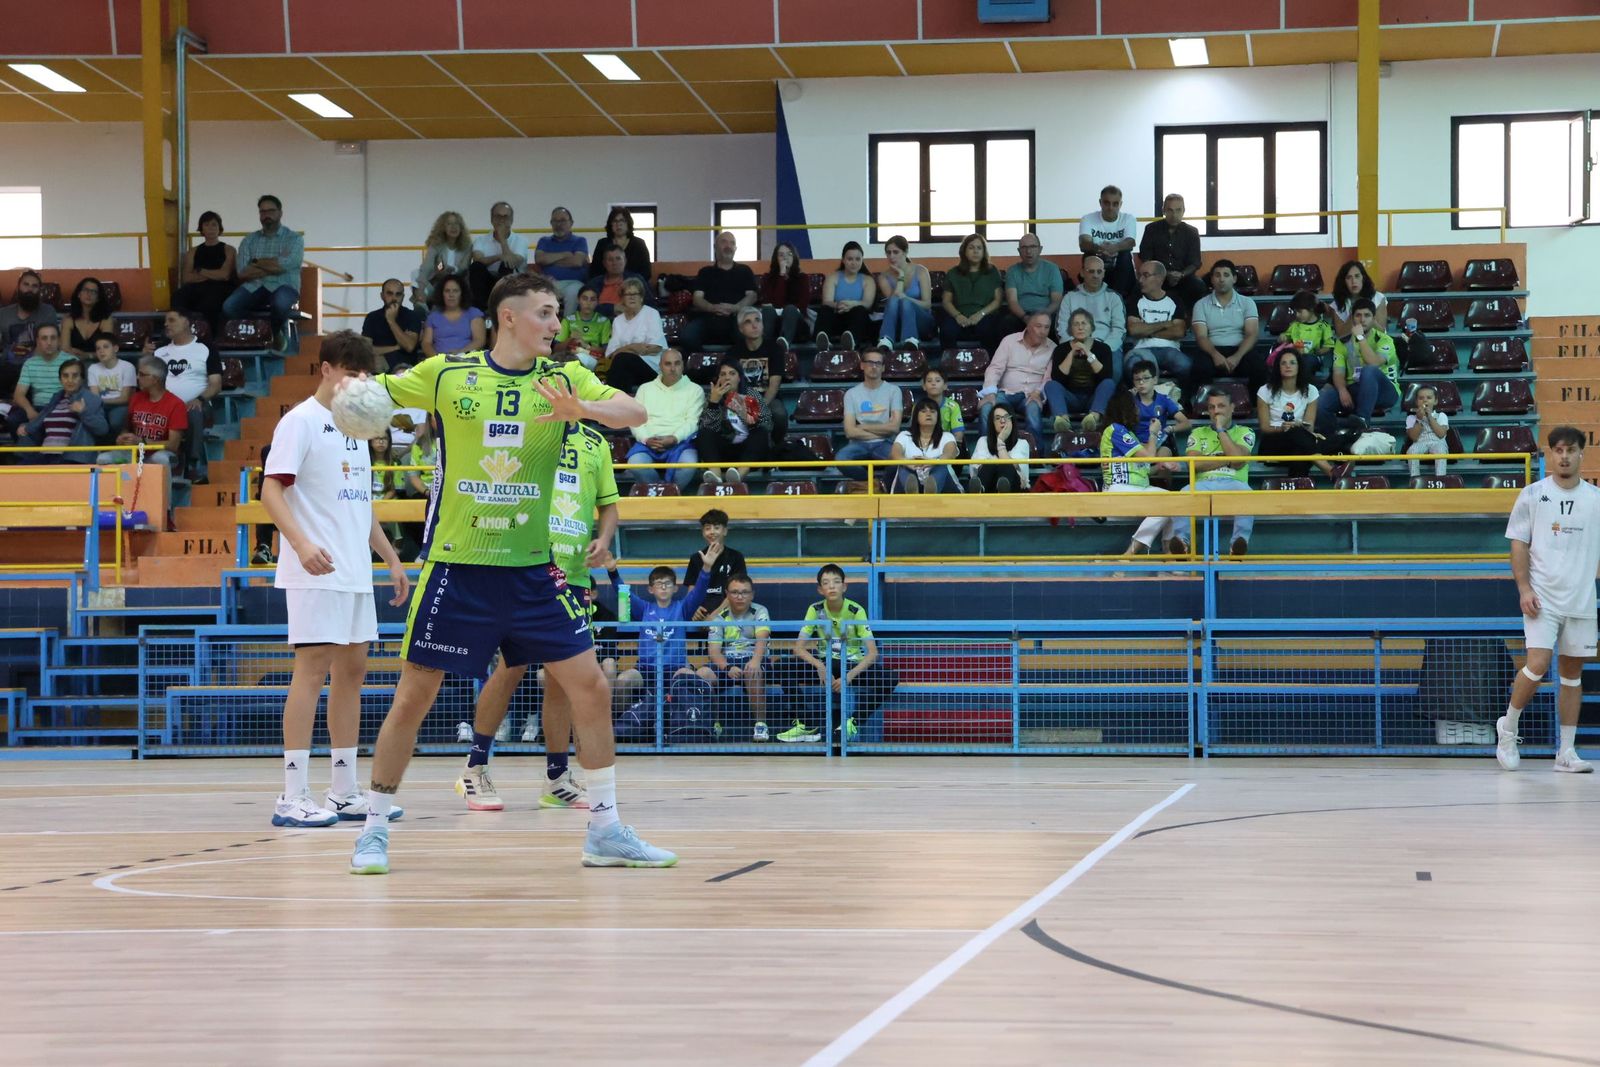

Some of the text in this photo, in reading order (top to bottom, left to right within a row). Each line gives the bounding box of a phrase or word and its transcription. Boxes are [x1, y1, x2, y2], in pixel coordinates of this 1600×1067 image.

[1483, 260, 1497, 272] 61
[1486, 299, 1500, 311] 61
[120, 322, 135, 333] 21
[1491, 341, 1508, 353] 61
[830, 353, 845, 365] 41
[167, 361, 193, 372] AMORA
[456, 384, 483, 392] ZAMORA
[1495, 382, 1511, 393] 61
[495, 390, 521, 417] 13
[817, 393, 830, 403] 41
[489, 423, 520, 438] gaza
[1496, 431, 1512, 440] 61
[1071, 436, 1087, 445] 49
[559, 472, 577, 484] gaza
[457, 481, 540, 497] CAJA RURAL
[715, 485, 734, 497] 39
[1559, 500, 1575, 515] 17
[471, 515, 516, 530] ZAMORA
[564, 518, 588, 533] RURAL
[183, 538, 231, 555] FILA
[414, 639, 469, 656] AUTORED.ES
